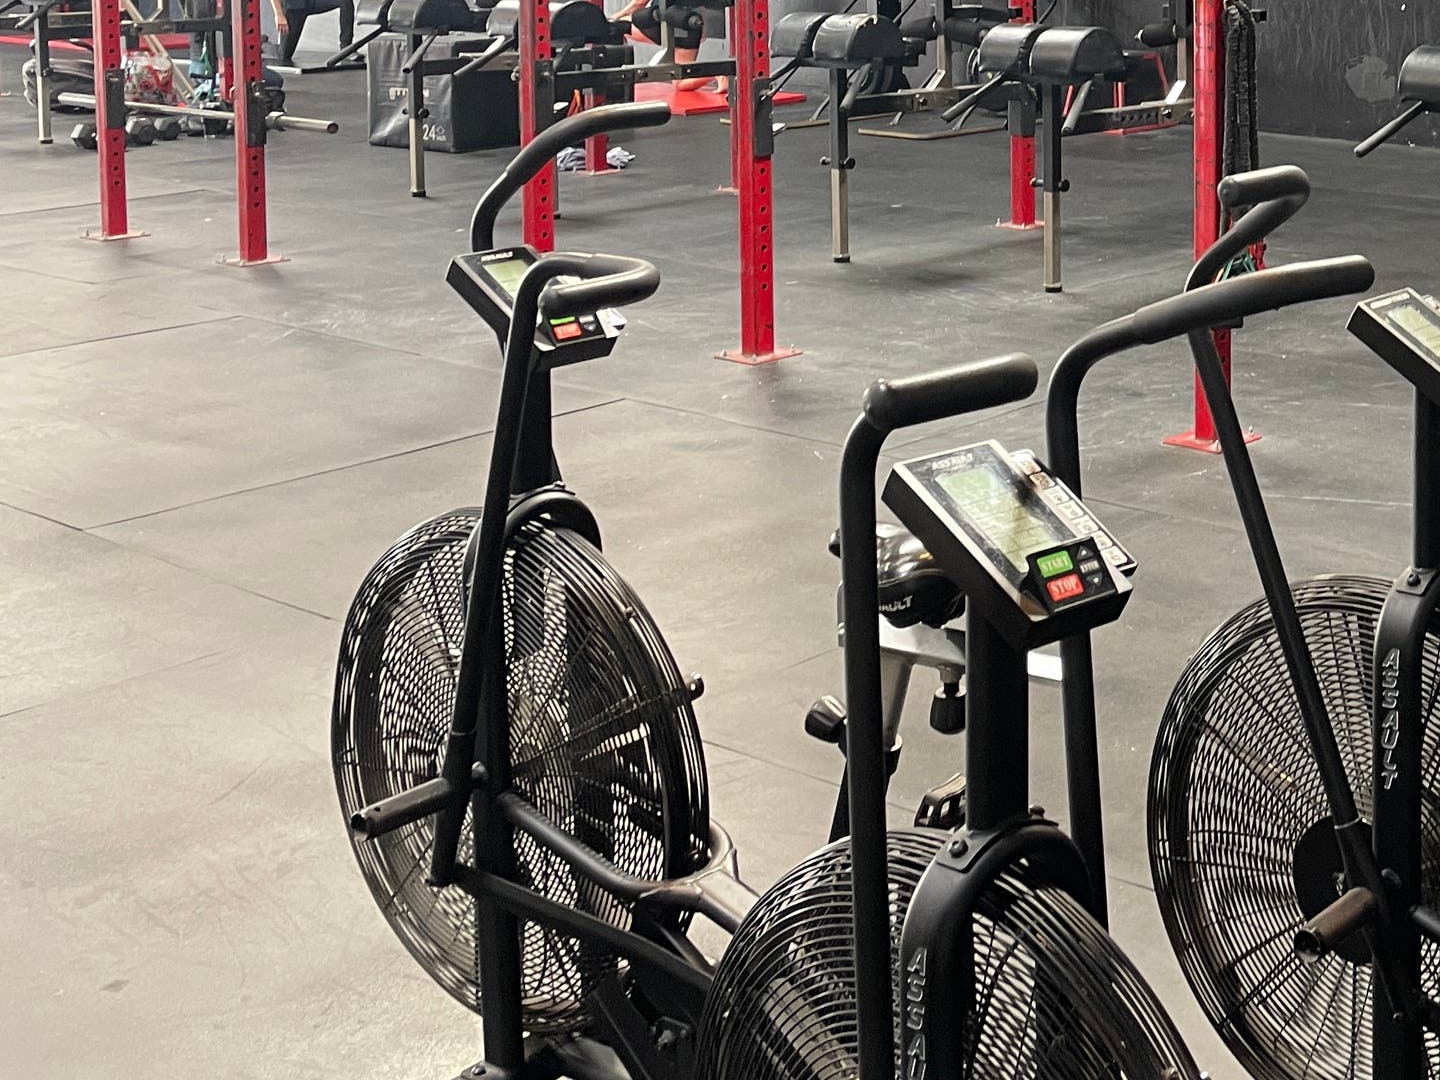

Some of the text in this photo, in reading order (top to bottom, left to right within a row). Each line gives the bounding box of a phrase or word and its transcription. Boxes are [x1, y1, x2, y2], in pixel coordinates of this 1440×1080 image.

[422, 123, 436, 142] 24
[1040, 555, 1069, 573] START
[1050, 575, 1078, 595] STOP
[1381, 648, 1400, 790] ASSAULT
